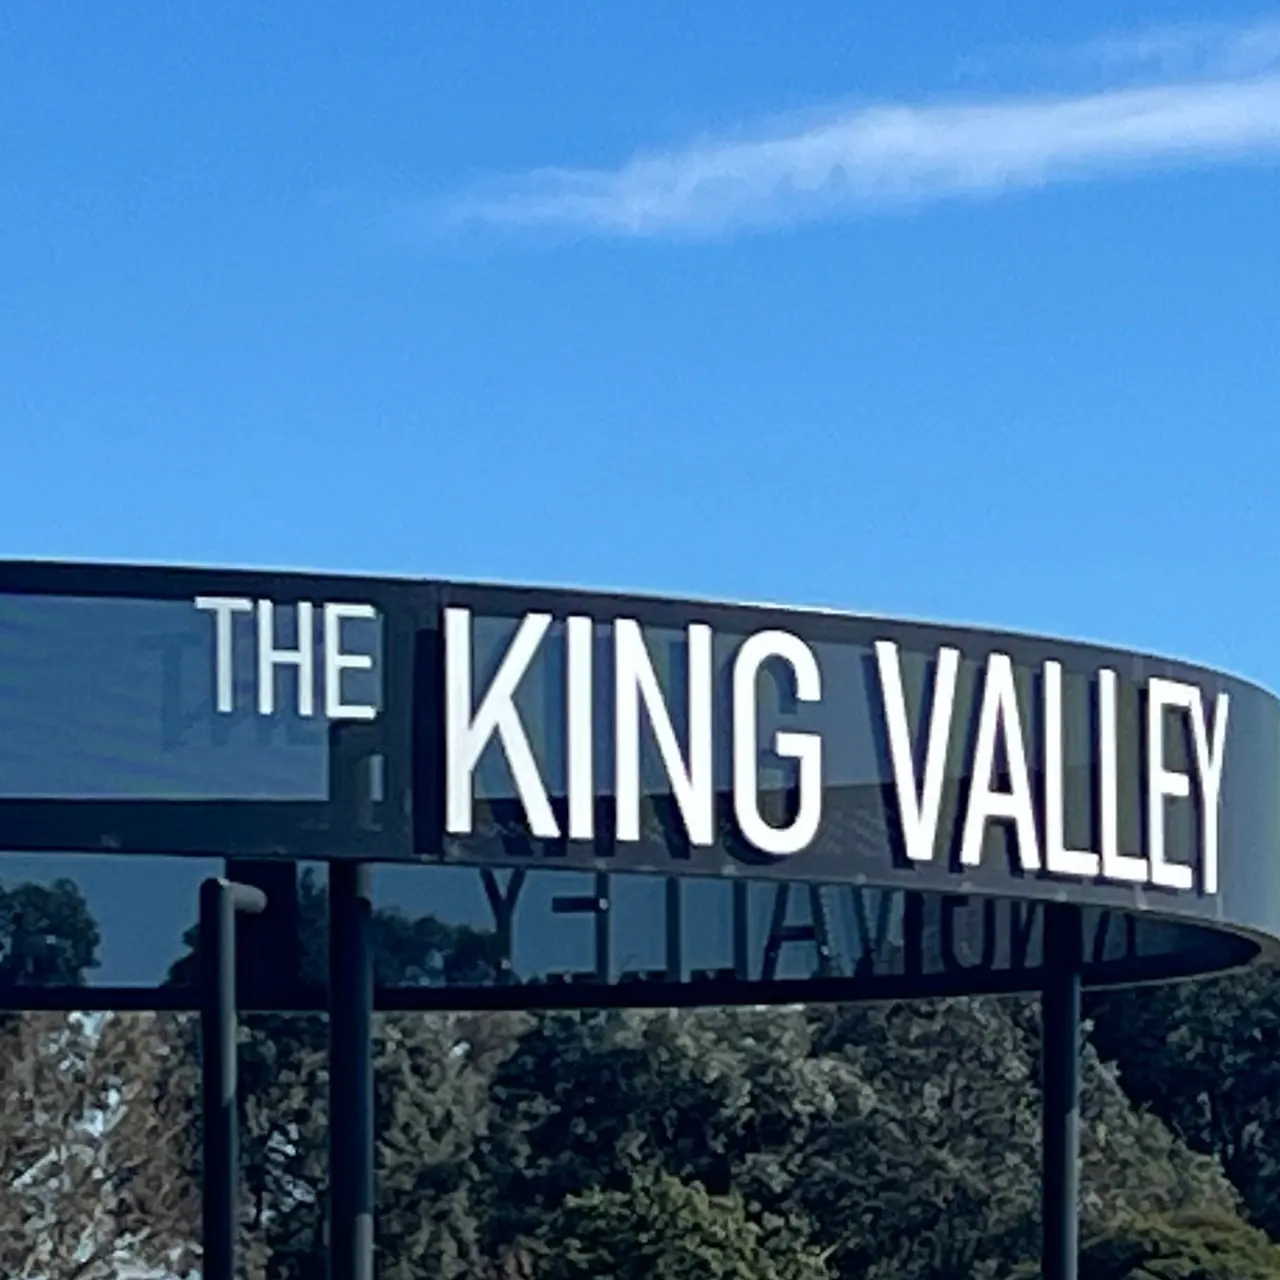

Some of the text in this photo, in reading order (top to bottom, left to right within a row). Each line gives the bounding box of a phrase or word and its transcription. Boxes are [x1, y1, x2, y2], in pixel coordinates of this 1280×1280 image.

[194, 596, 1230, 895] THE KING VALLEY
